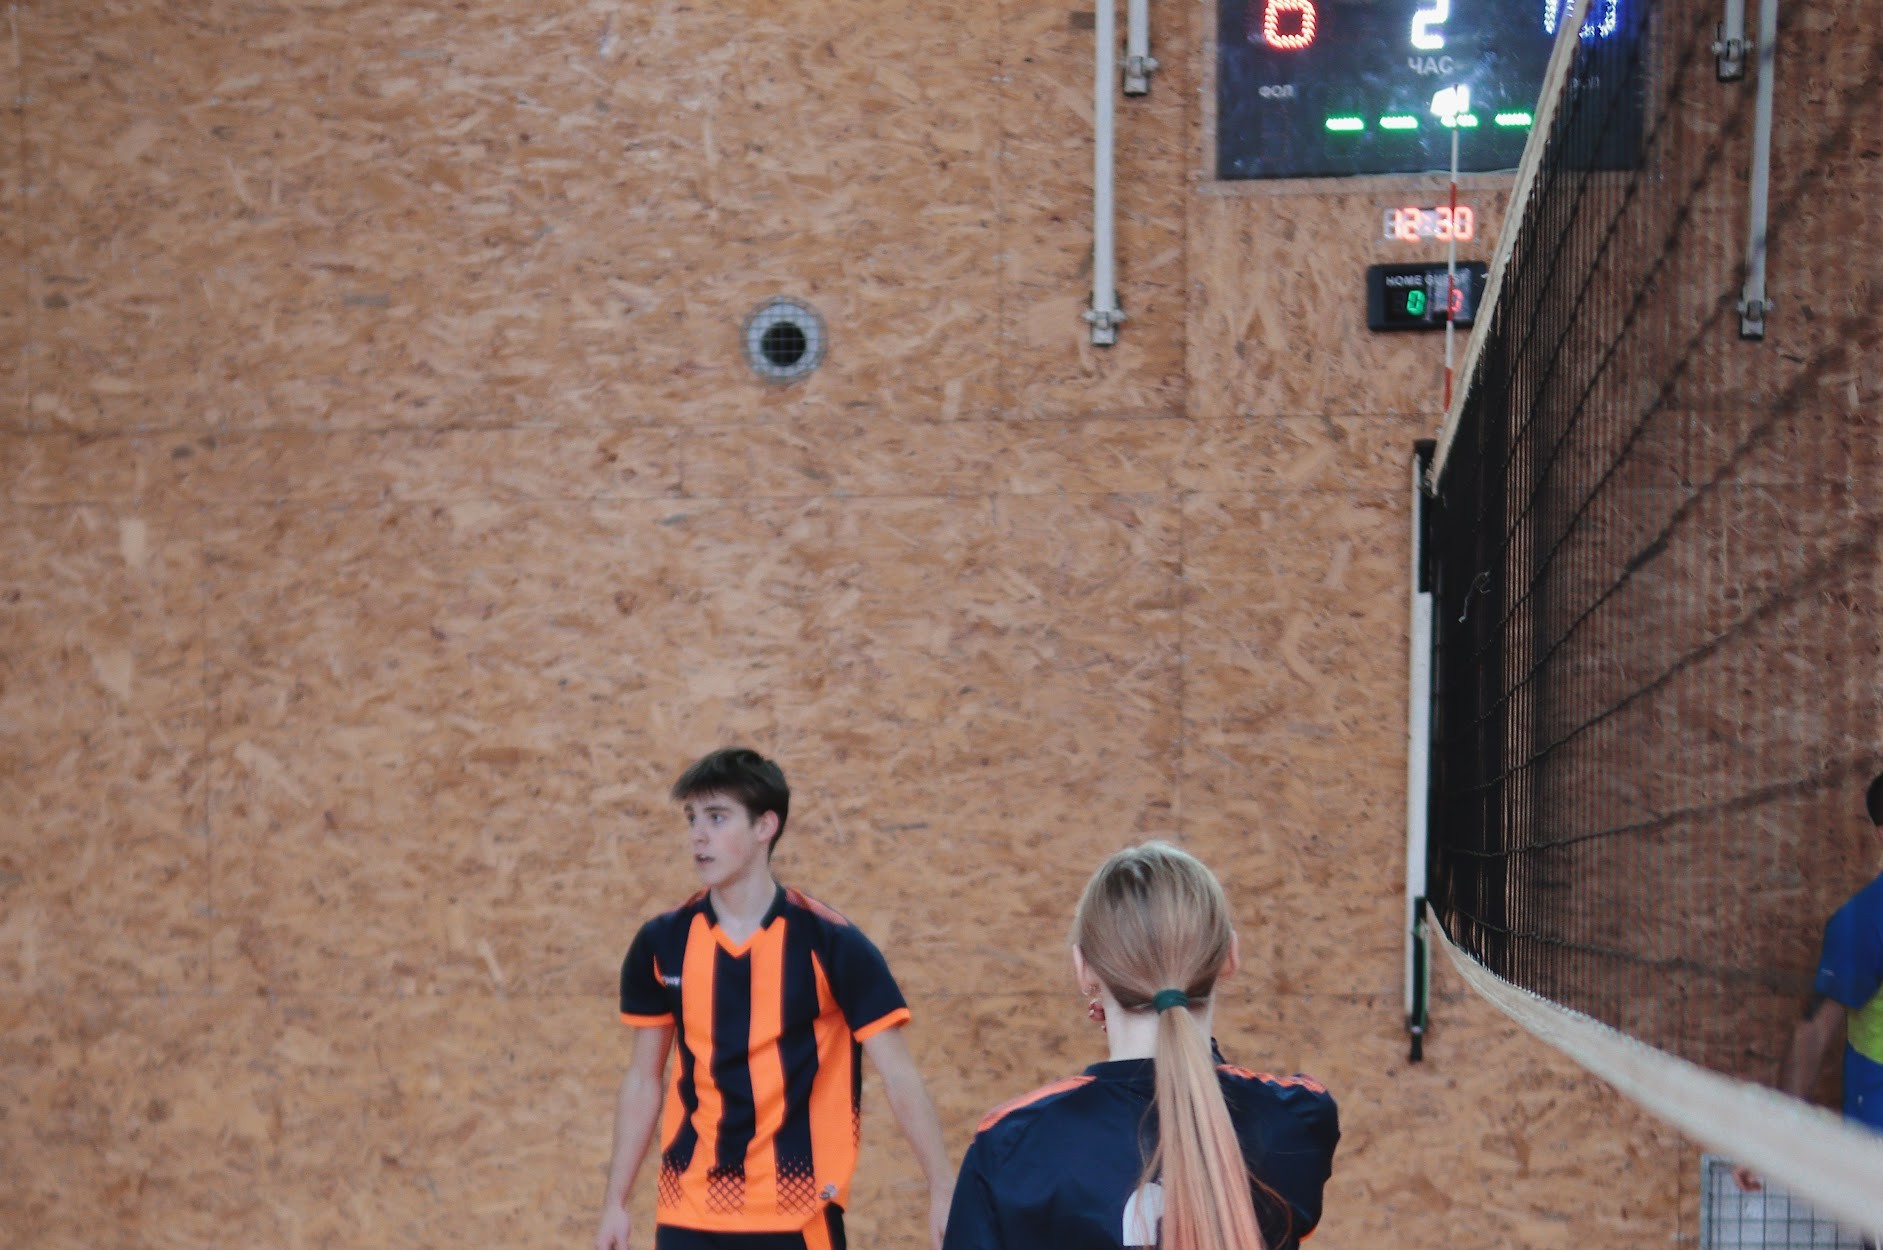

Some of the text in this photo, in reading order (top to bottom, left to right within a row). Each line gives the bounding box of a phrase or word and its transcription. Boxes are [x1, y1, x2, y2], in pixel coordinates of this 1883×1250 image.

[1408, 55, 1454, 75] ЧАС
[1385, 274, 1424, 288] HOME
[1406, 290, 1427, 315] 0
